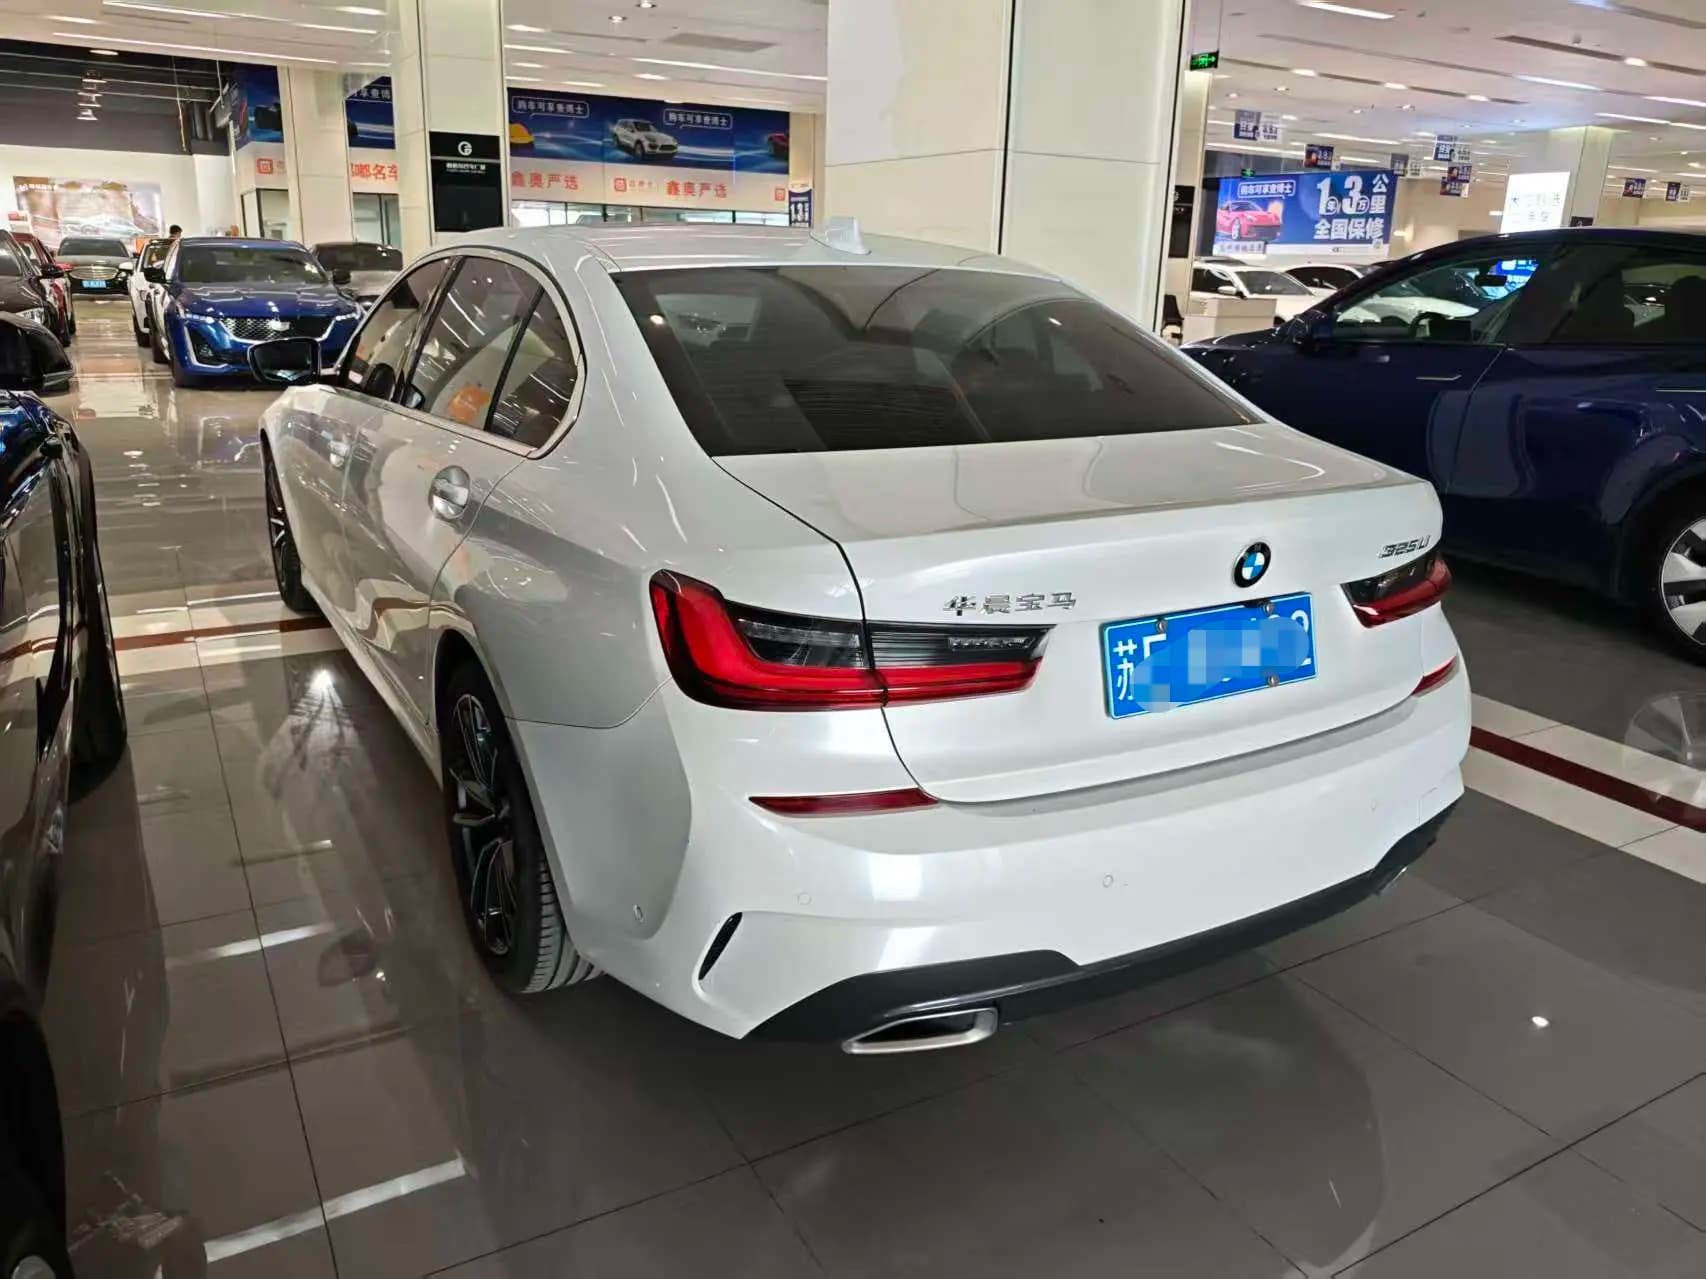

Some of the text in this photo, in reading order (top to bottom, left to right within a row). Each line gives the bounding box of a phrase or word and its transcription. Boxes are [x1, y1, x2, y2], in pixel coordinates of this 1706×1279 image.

[1312, 217, 1385, 240] 全国保修
[942, 592, 1077, 617] 华晨宝马
